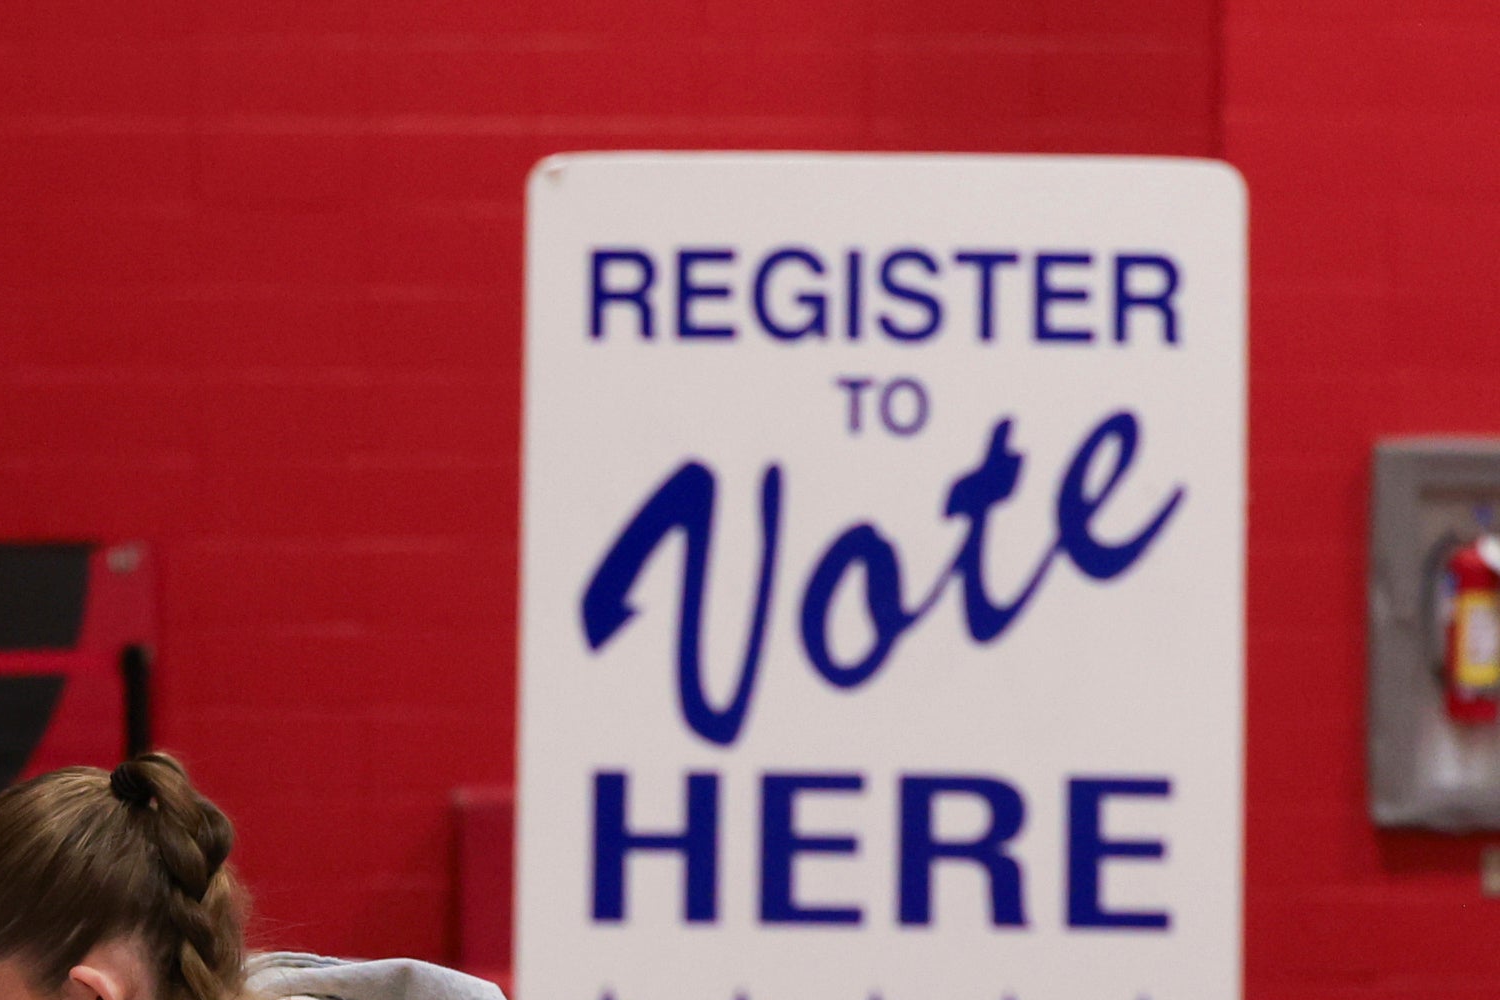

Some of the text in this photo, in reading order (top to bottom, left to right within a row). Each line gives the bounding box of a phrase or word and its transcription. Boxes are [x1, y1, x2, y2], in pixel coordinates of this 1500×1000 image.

[587, 245, 1182, 347] REGISTER
[836, 375, 931, 438] TO
[579, 410, 1185, 748] Vote
[589, 769, 1175, 932] HERE
